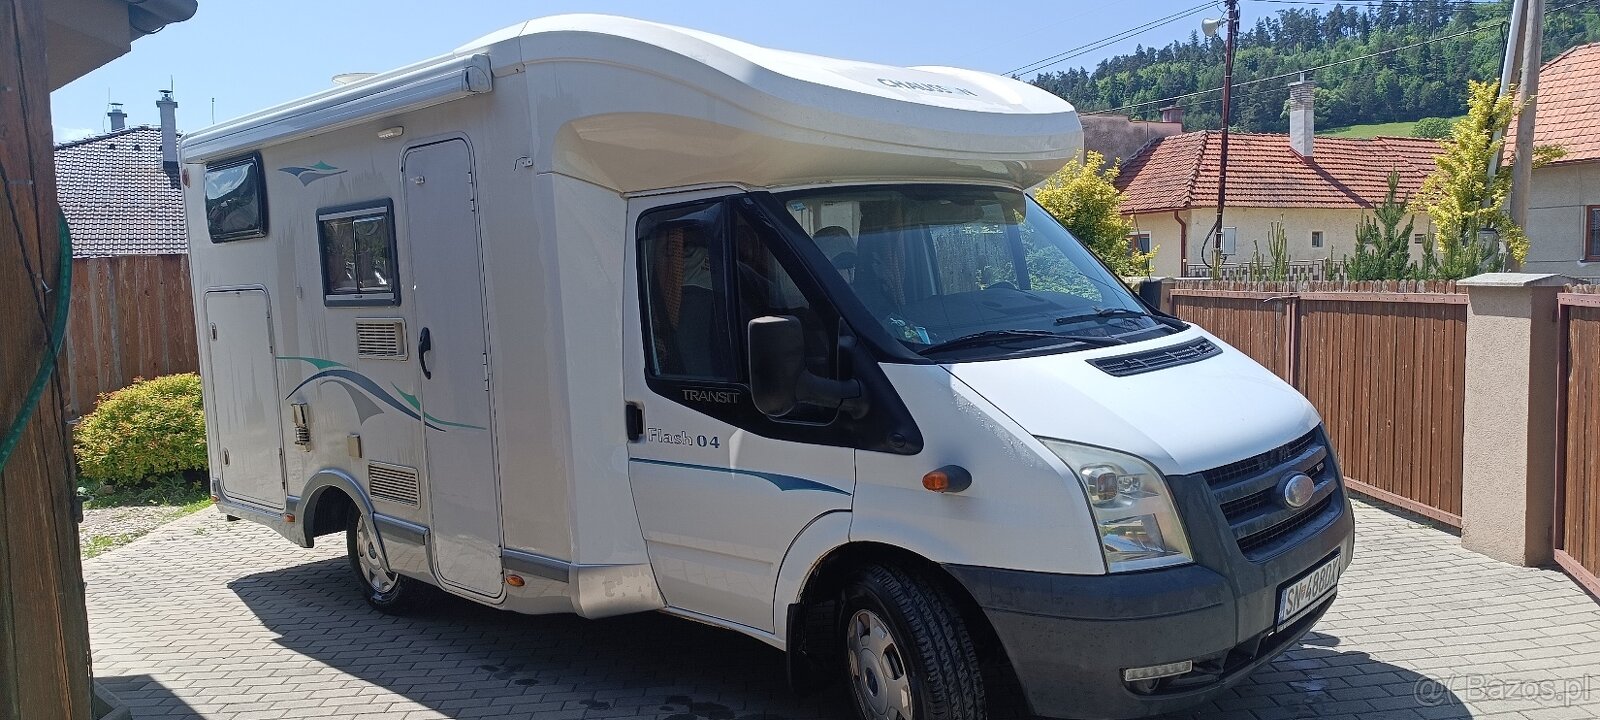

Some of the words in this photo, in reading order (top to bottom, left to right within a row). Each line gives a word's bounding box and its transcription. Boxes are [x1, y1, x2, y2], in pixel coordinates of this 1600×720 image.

[877, 78, 978, 97] CHAUSSN
[682, 389, 740, 404] TRANSIT
[648, 427, 693, 446] Flash
[696, 435, 720, 449] 04
